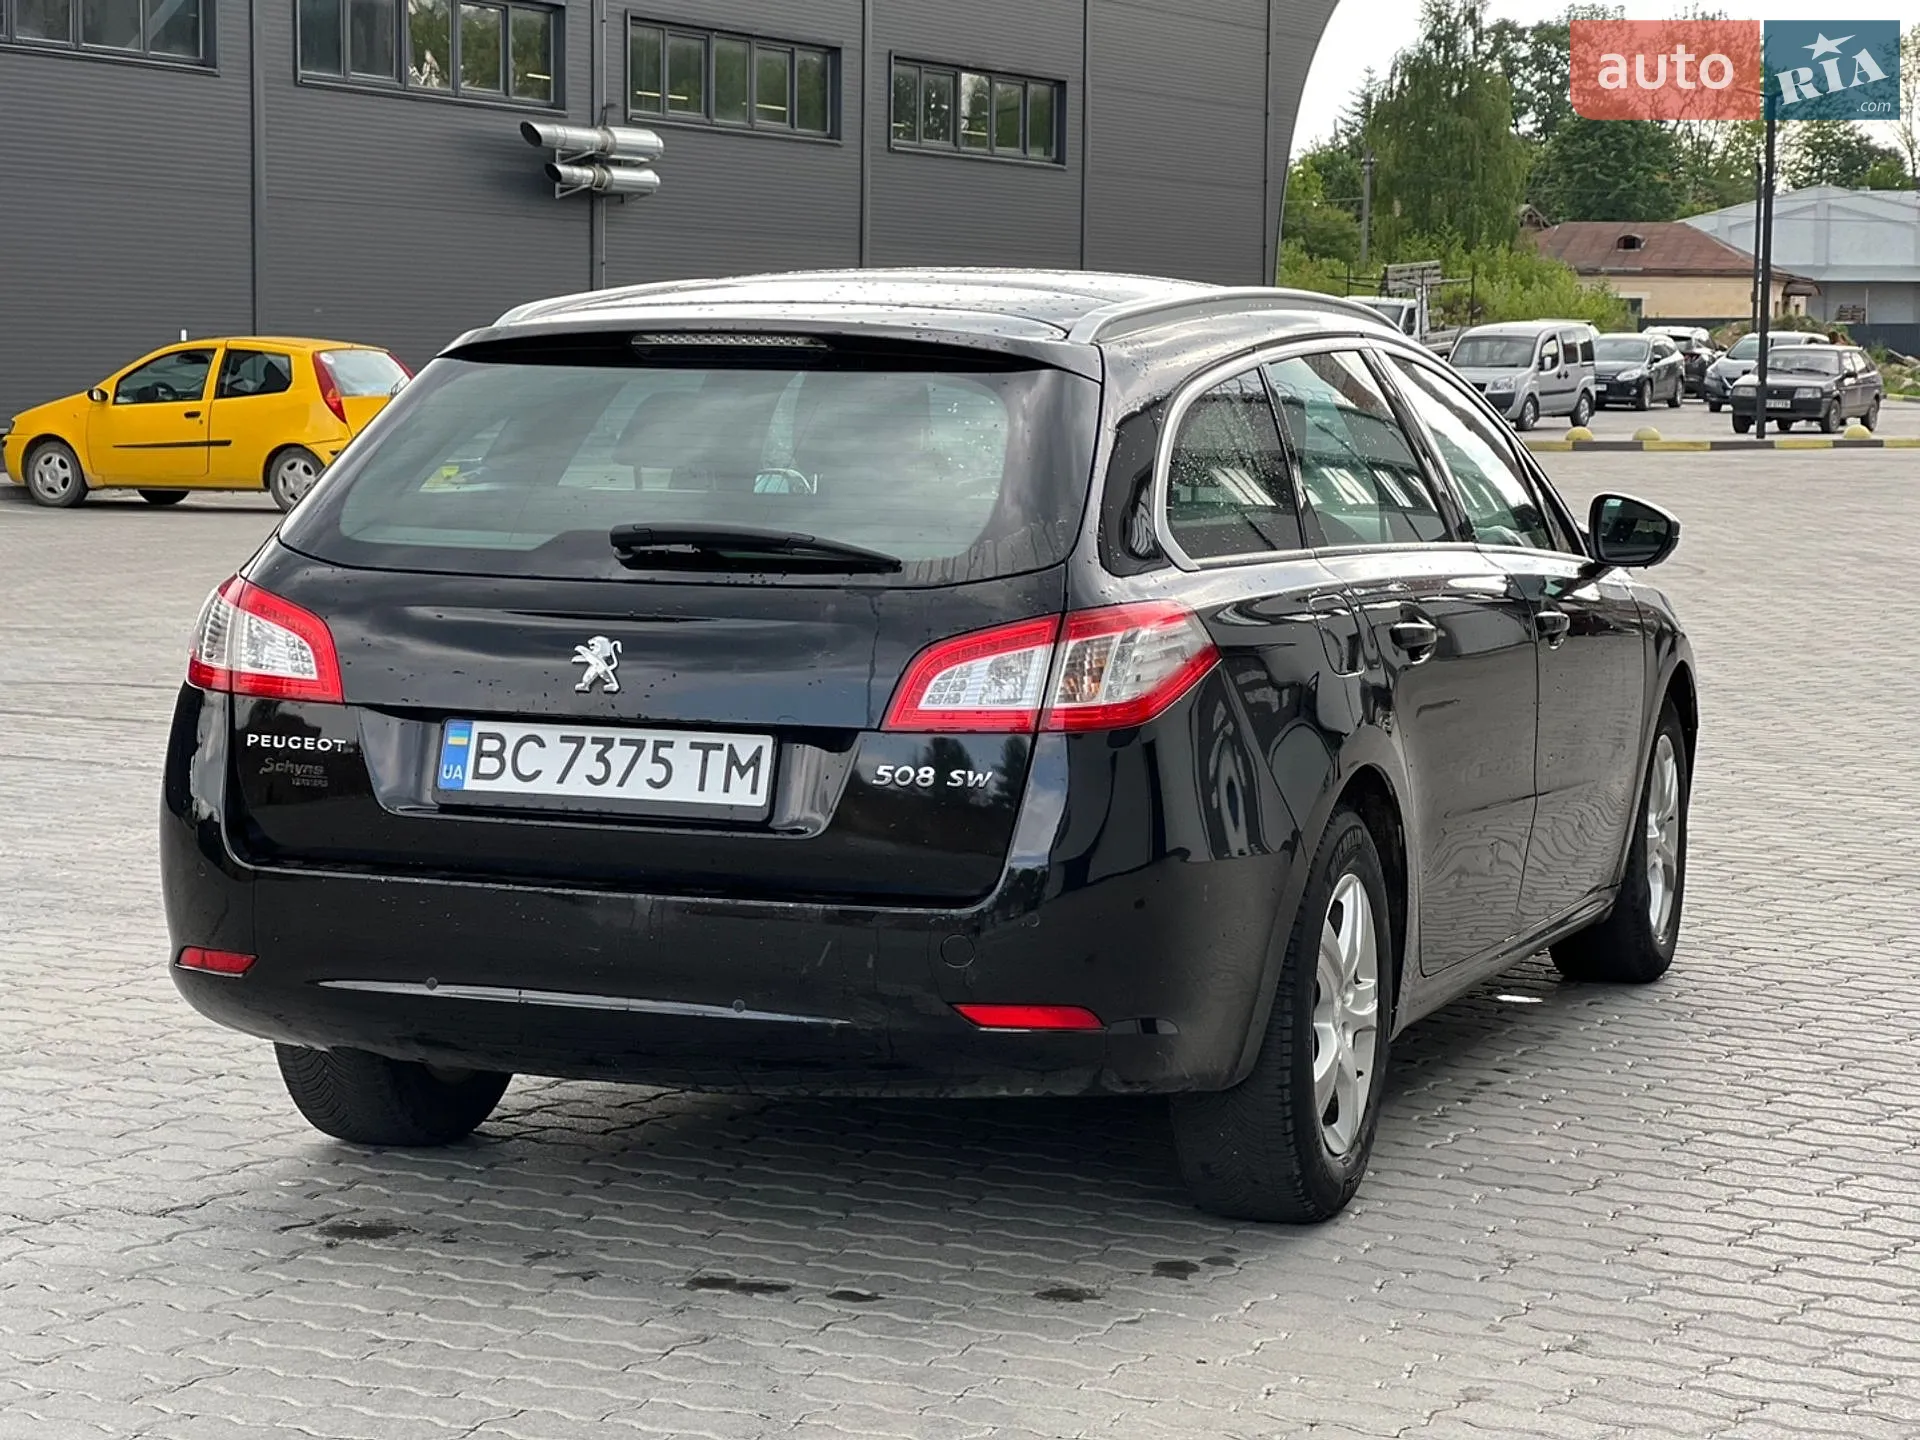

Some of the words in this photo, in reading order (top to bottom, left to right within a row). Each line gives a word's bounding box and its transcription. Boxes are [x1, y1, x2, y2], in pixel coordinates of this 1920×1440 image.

[246, 733, 347, 753] PEUGEOT
[442, 763, 464, 780] UA
[471, 731, 547, 783] BC
[556, 735, 675, 790] 7375
[689, 741, 764, 796] TM
[872, 765, 936, 788] 508
[946, 769, 993, 789] SW
